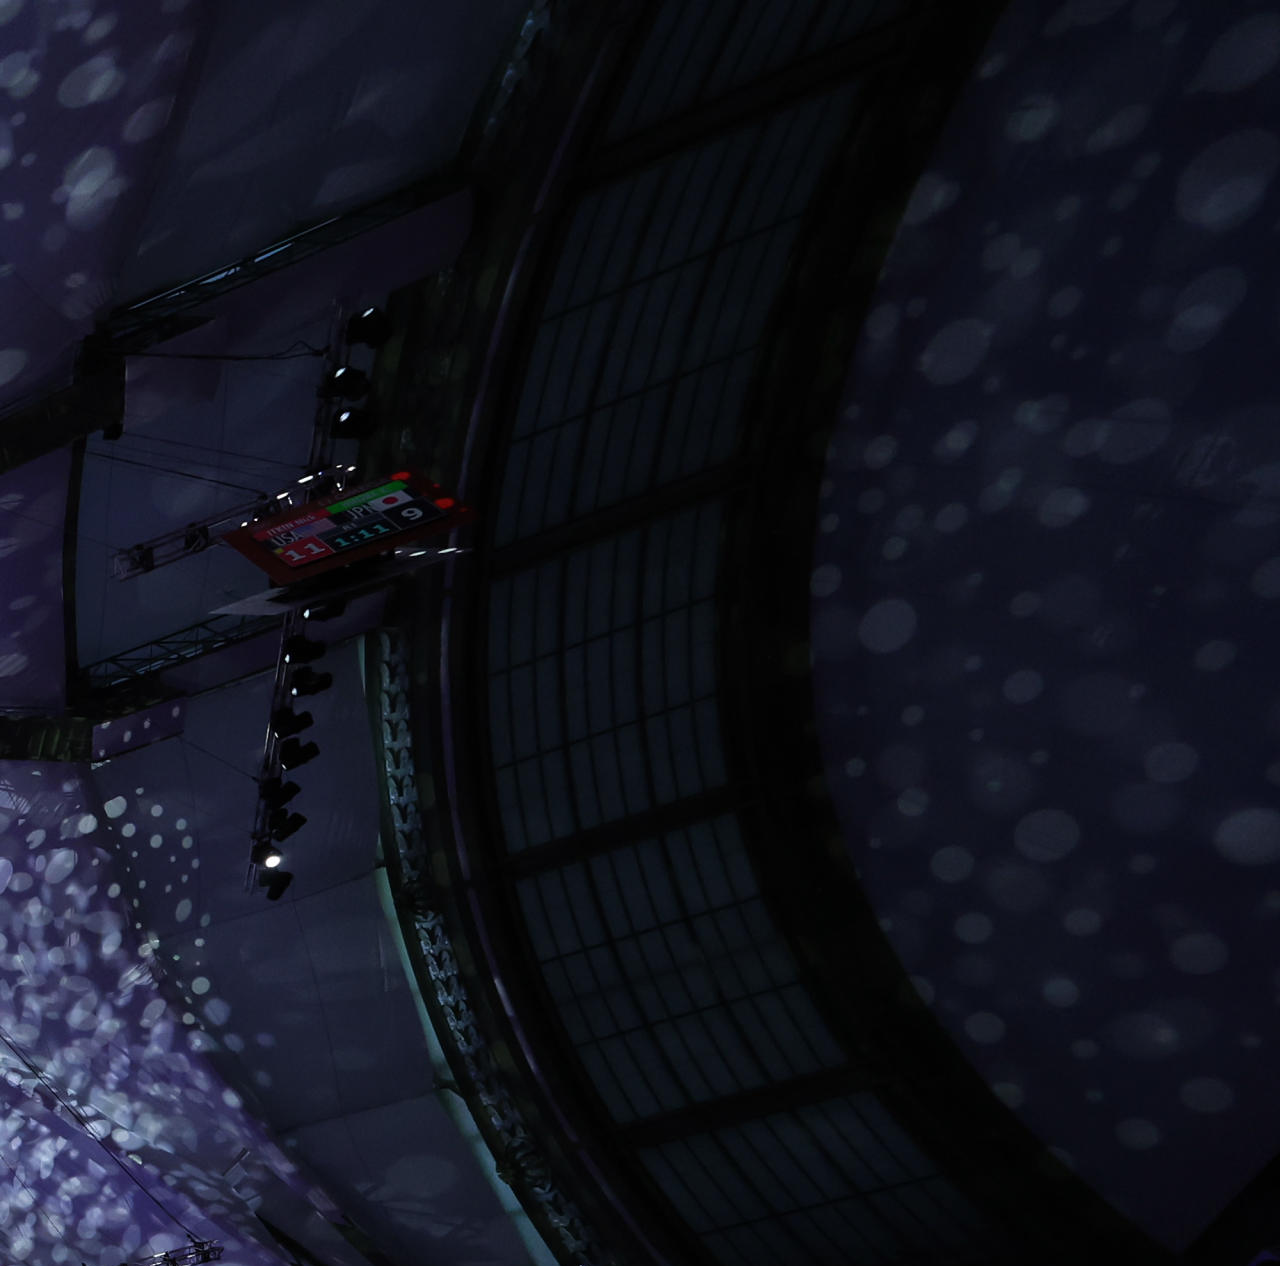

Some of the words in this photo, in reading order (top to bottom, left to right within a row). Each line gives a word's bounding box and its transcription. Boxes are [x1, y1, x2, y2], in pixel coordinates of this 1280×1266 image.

[400, 508, 424, 520] 9
[271, 530, 304, 546] USA
[334, 522, 391, 548] 1:11
[285, 542, 326, 562] 11
